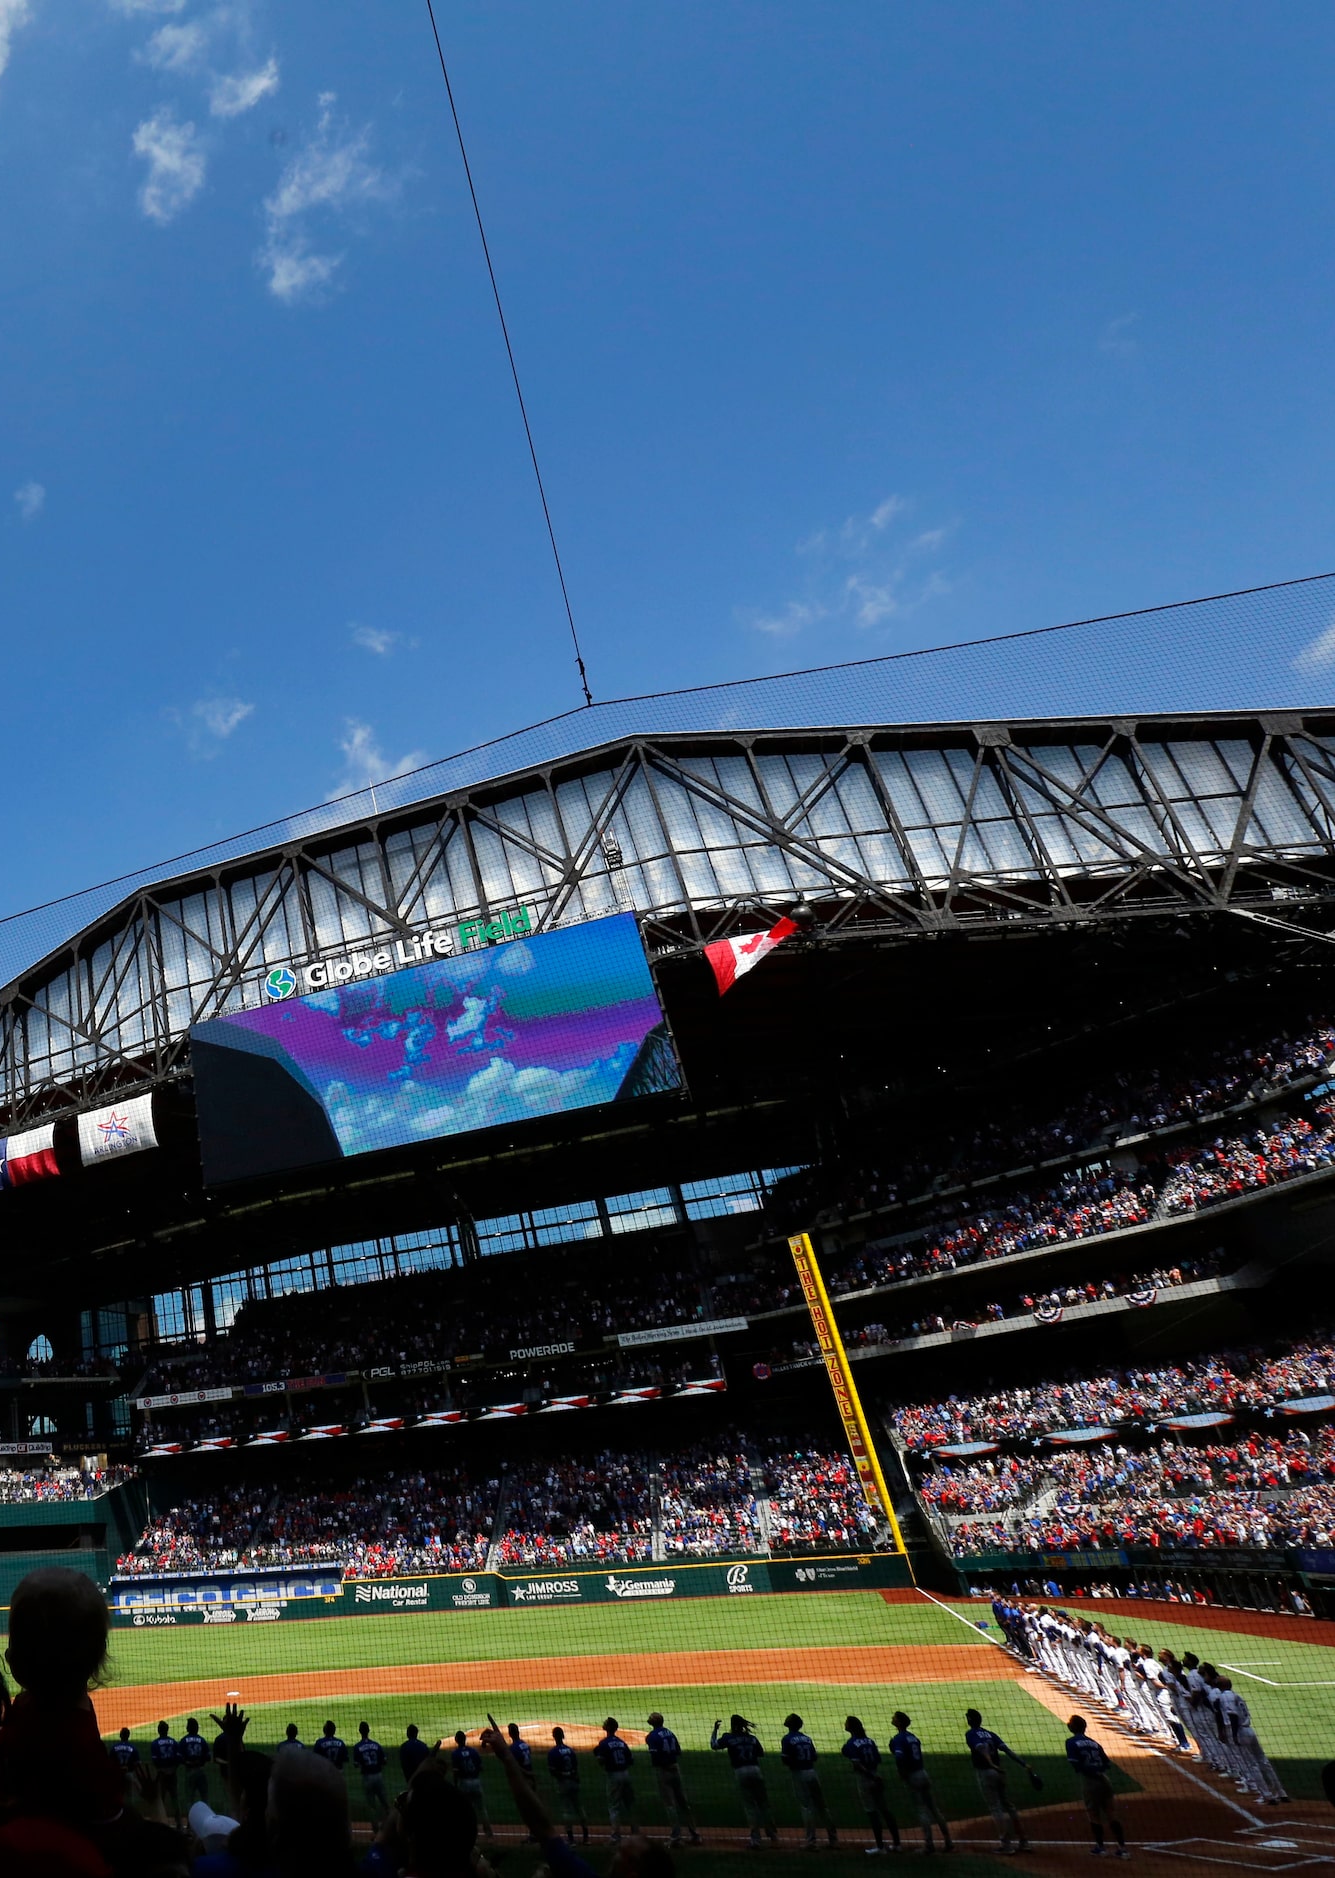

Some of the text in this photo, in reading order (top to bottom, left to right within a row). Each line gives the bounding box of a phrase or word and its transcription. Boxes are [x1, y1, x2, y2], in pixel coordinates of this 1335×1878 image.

[304, 905, 532, 987] Globe Life Field
[94, 1135, 138, 1155] ARLINGTON
[798, 1258, 816, 1299] THE
[813, 1307, 831, 1349] HOT
[828, 1357, 853, 1415] ZONE
[509, 1342, 576, 1360] POWERADE
[370, 1366, 395, 1378] PGL
[262, 1381, 286, 1393] 105.3
[625, 1577, 675, 1590] Germania
[727, 1564, 748, 1585] B
[230, 1578, 342, 1609] GEICO
[372, 1582, 428, 1601] National
[729, 1584, 753, 1593] SPORTS
[118, 1584, 223, 1615] GEICO
[405, 1598, 427, 1606] Rental
[146, 1614, 177, 1624] Kubota
